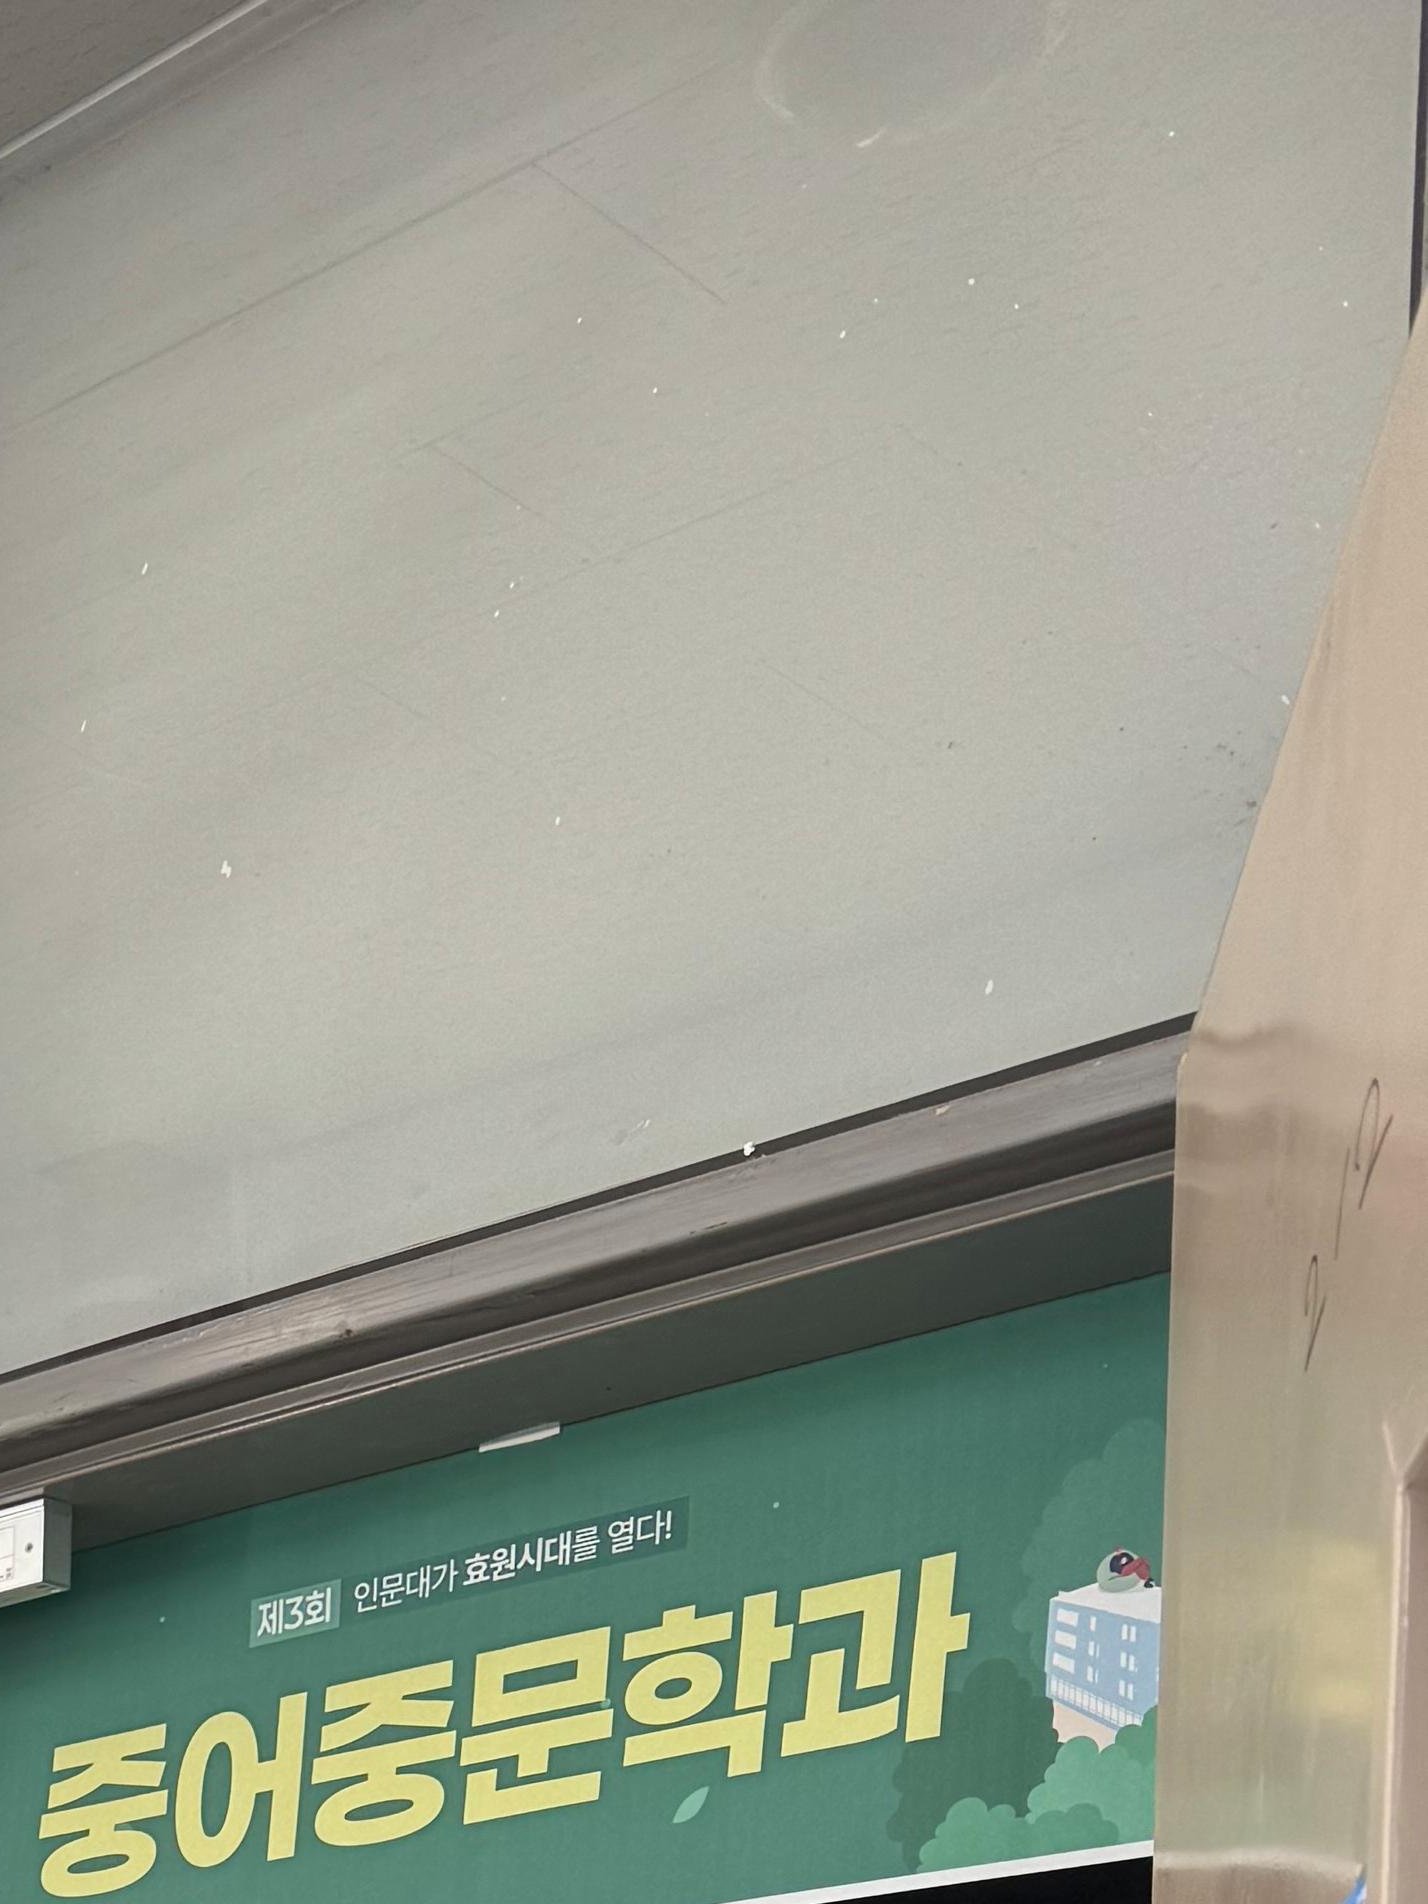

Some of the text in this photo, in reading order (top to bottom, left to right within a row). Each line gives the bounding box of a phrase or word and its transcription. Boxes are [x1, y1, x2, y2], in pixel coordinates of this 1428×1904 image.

[257, 1587, 331, 1637] 제3회
[355, 1511, 671, 1612] 인문대가 효원시대를 열다!
[39, 1552, 970, 1897] 중어중문학과
